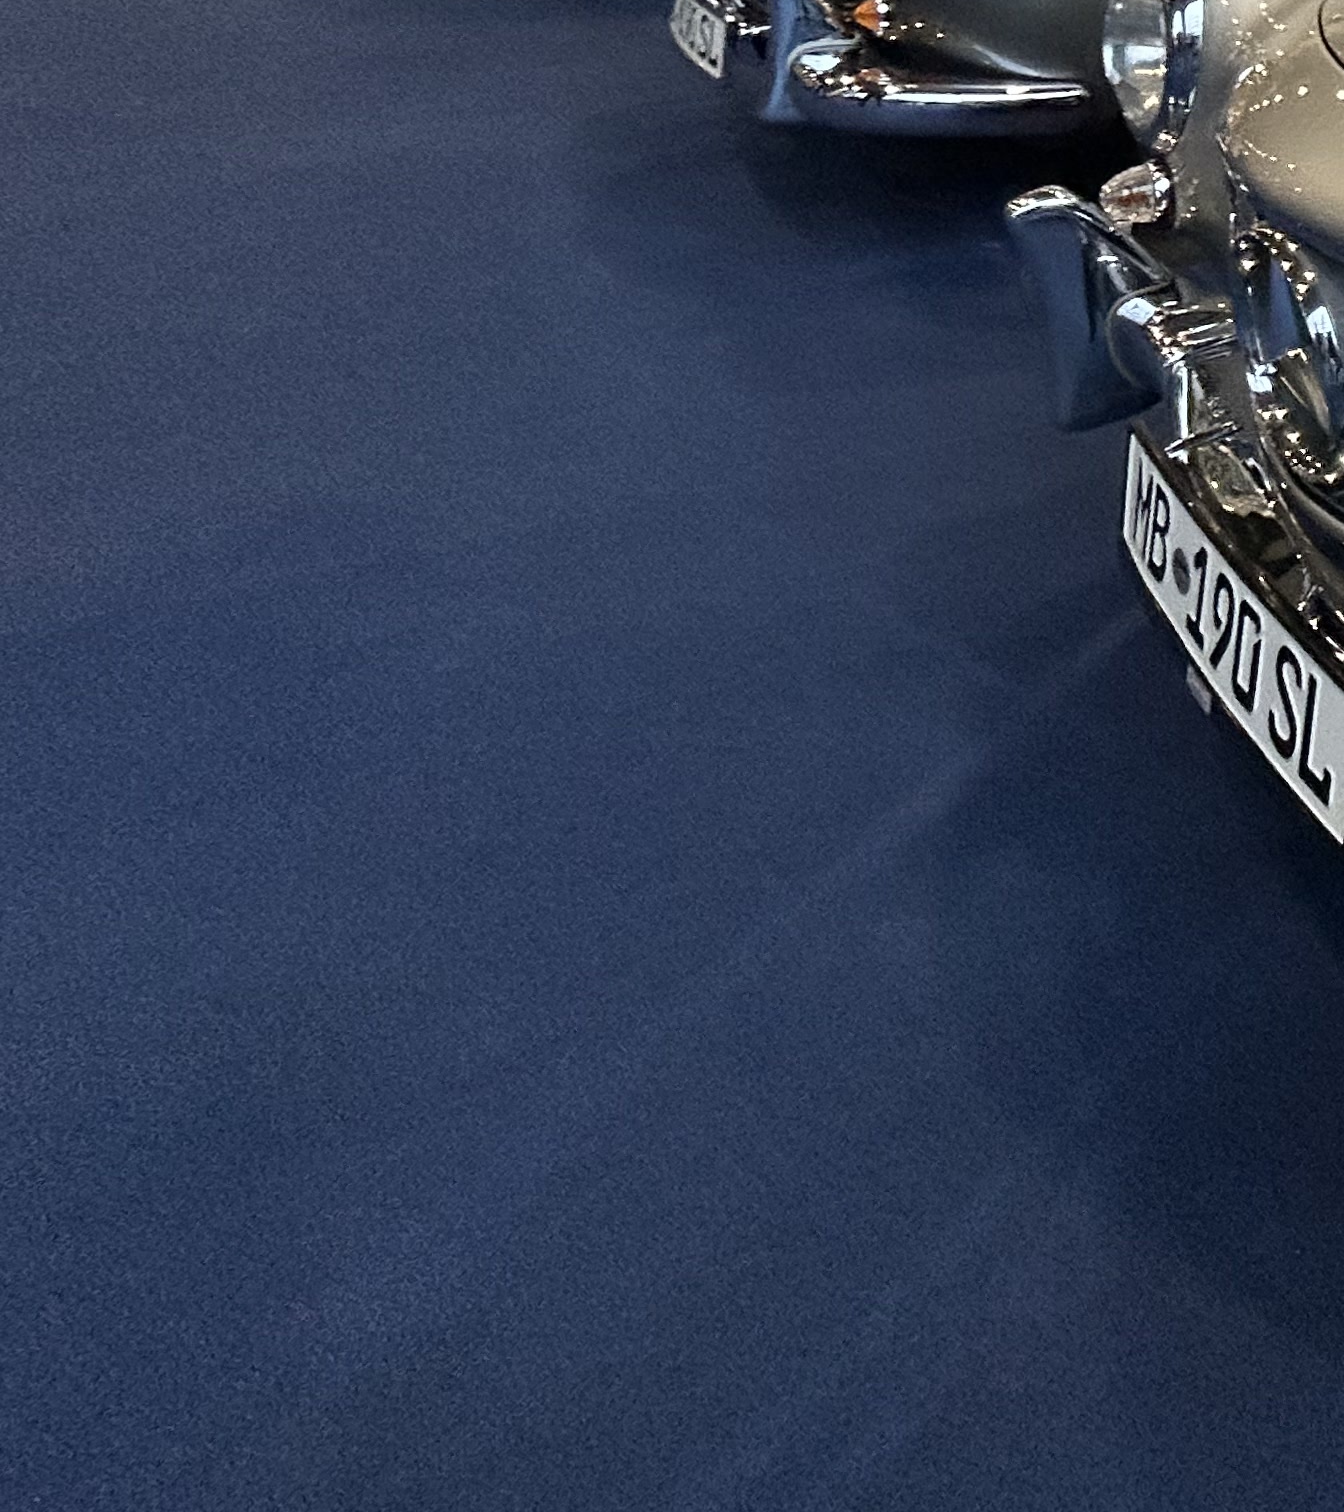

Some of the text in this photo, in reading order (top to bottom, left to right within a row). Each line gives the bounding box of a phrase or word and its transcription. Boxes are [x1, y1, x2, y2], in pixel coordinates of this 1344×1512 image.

[1132, 454, 1332, 809] MB 190 SL
